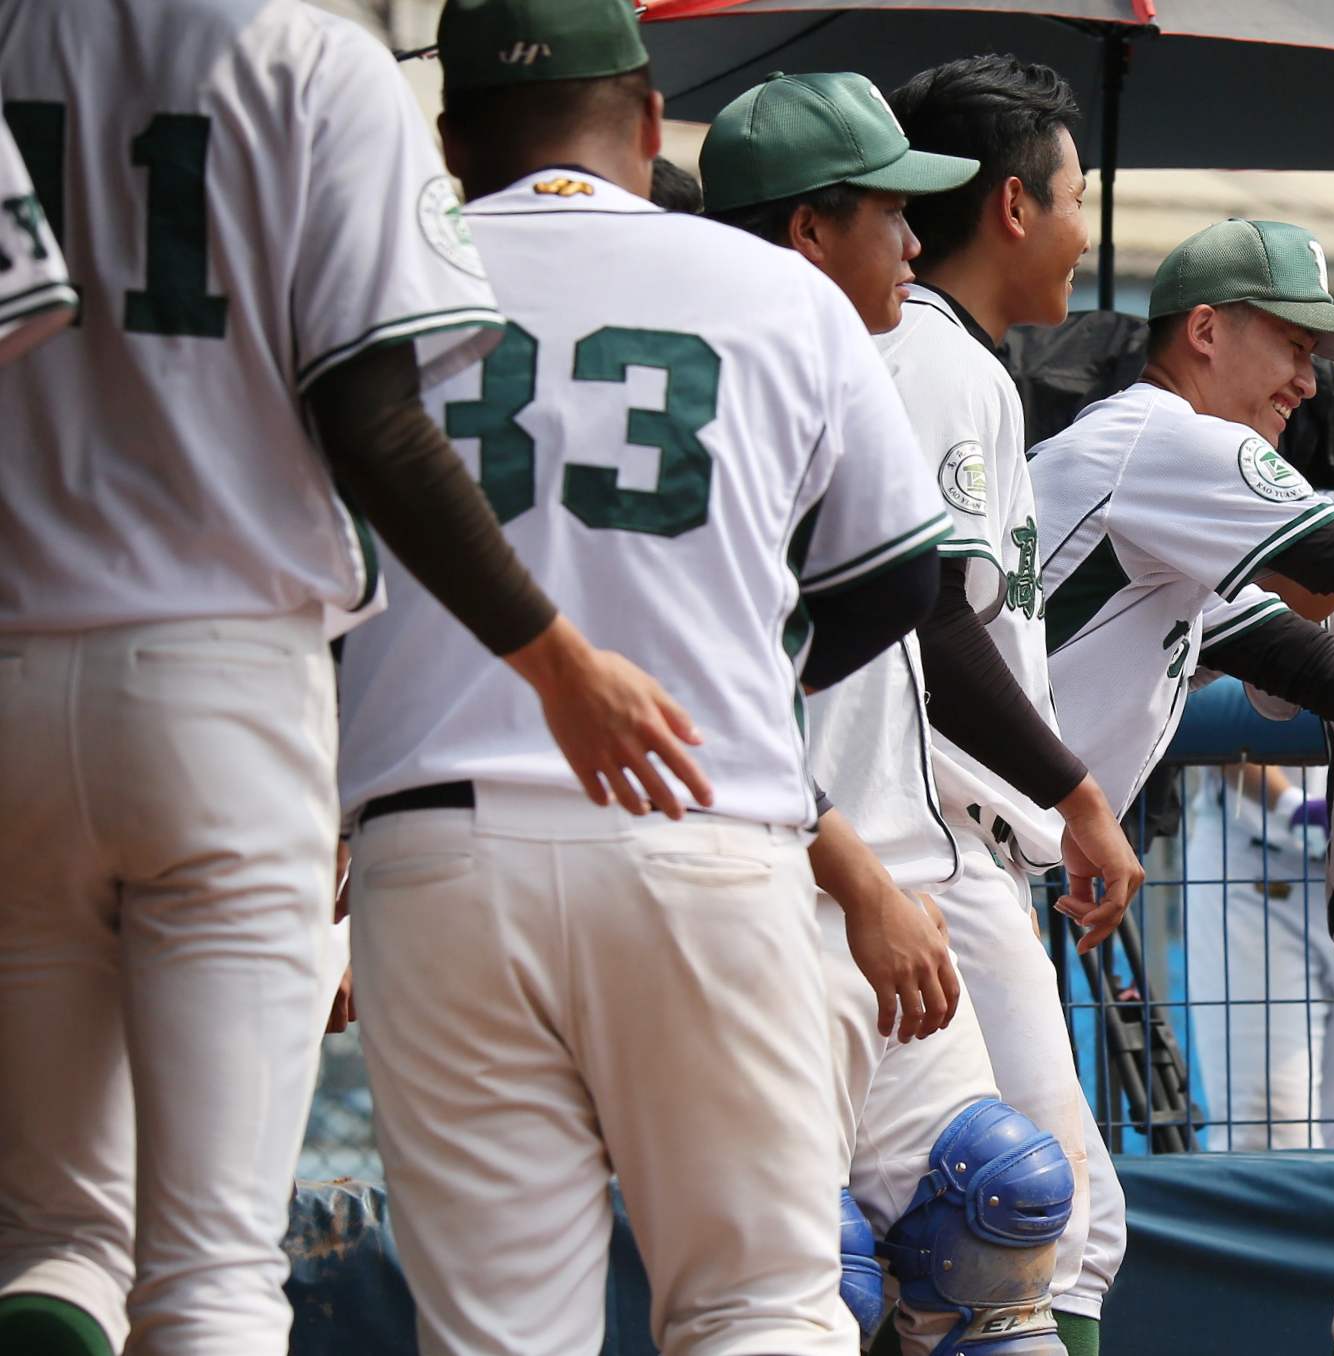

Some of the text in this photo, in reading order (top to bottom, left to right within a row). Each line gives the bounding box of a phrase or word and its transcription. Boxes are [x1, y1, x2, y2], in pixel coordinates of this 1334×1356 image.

[444, 319, 722, 540] 33
[1256, 482, 1297, 498] KAO YUAN
[1007, 515, 1046, 620] 高
